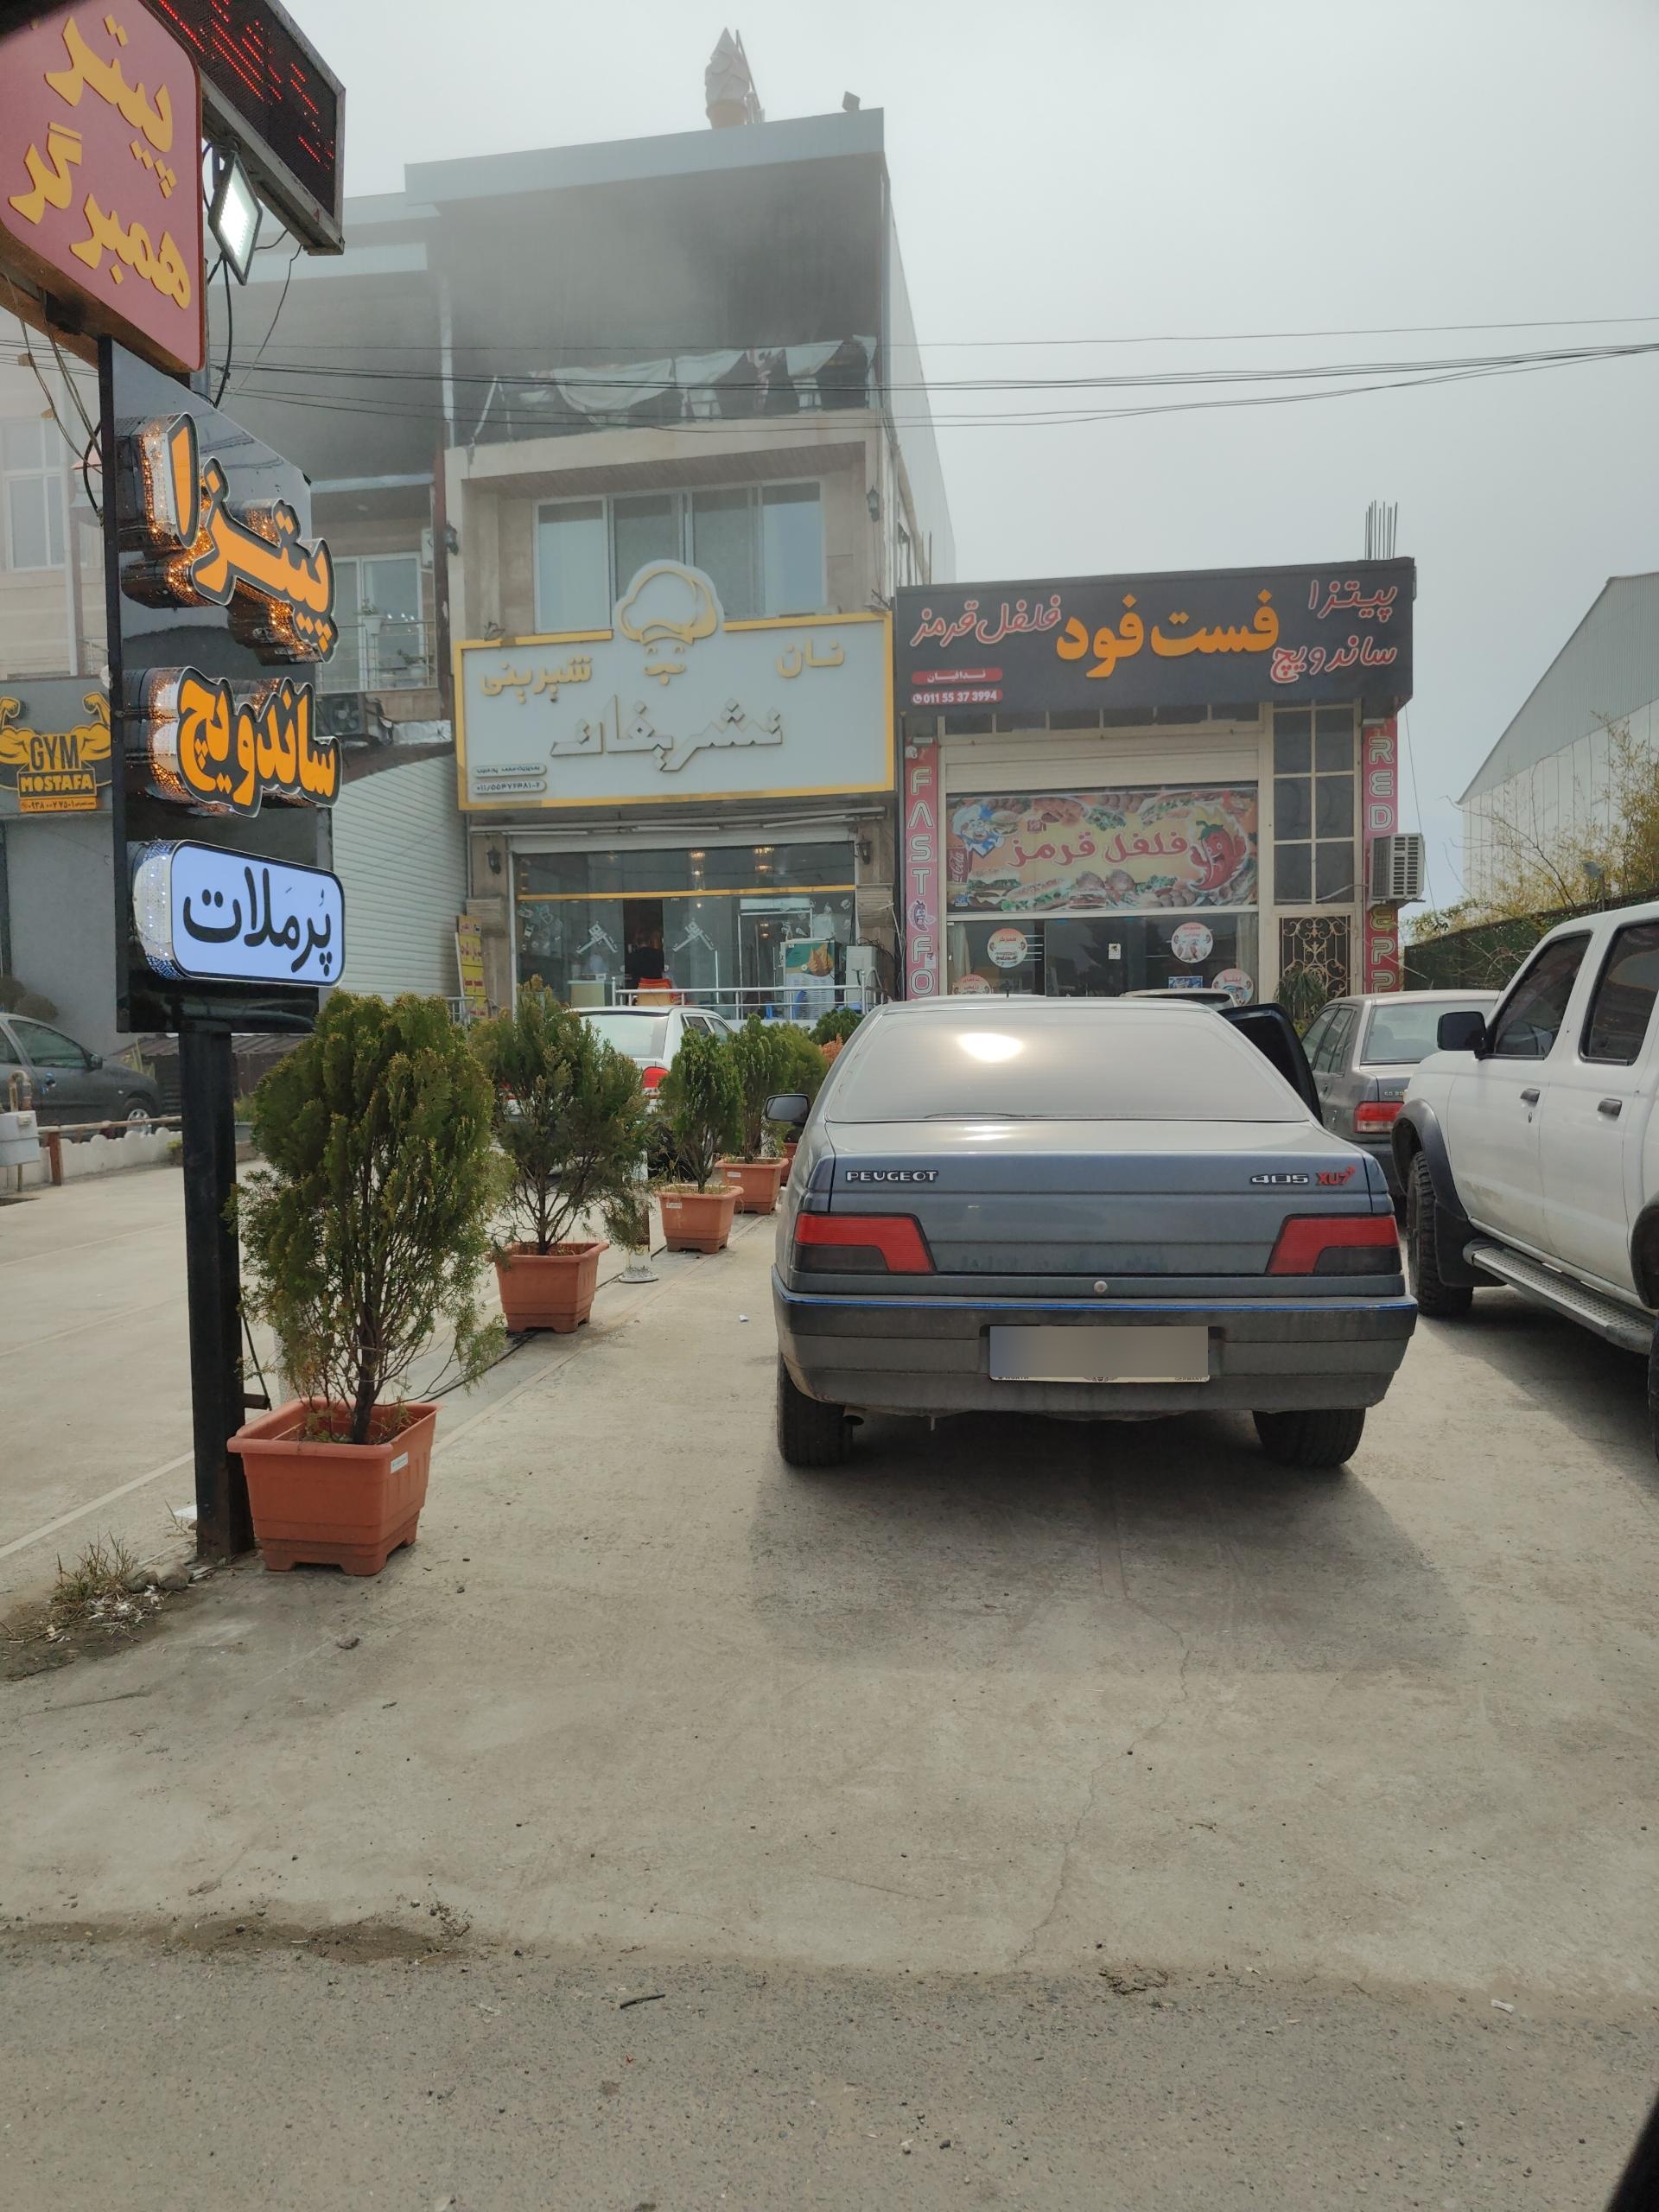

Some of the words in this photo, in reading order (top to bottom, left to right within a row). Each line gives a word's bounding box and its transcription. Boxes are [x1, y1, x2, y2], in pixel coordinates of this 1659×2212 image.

[172, 426, 333, 653] پیتزا
[909, 600, 980, 647] قرمز
[976, 594, 1062, 645] فلفل
[1150, 588, 1281, 658] فست
[1308, 580, 1398, 623] پیتزا
[777, 637, 846, 679] نان
[1056, 594, 1145, 678] فود
[1270, 635, 1398, 683] ساندویچ
[480, 654, 594, 705] شیرینی
[923, 694, 940, 704] 011
[942, 692, 955, 703] 55
[957, 691, 970, 702] 37
[971, 690, 997, 702] 3994
[30, 735, 80, 771] GYM
[180, 679, 335, 806] ساندویچ
[20, 773, 95, 793] MOSTAFA
[1369, 737, 1394, 832] RED
[908, 766, 934, 895] FAST
[1007, 831, 1096, 868] قرمز
[1104, 831, 1188, 864] فلفل
[910, 936, 935, 995] FO
[846, 1170, 938, 1182] PEUGEOT
[1250, 1173, 1309, 1185] 405
